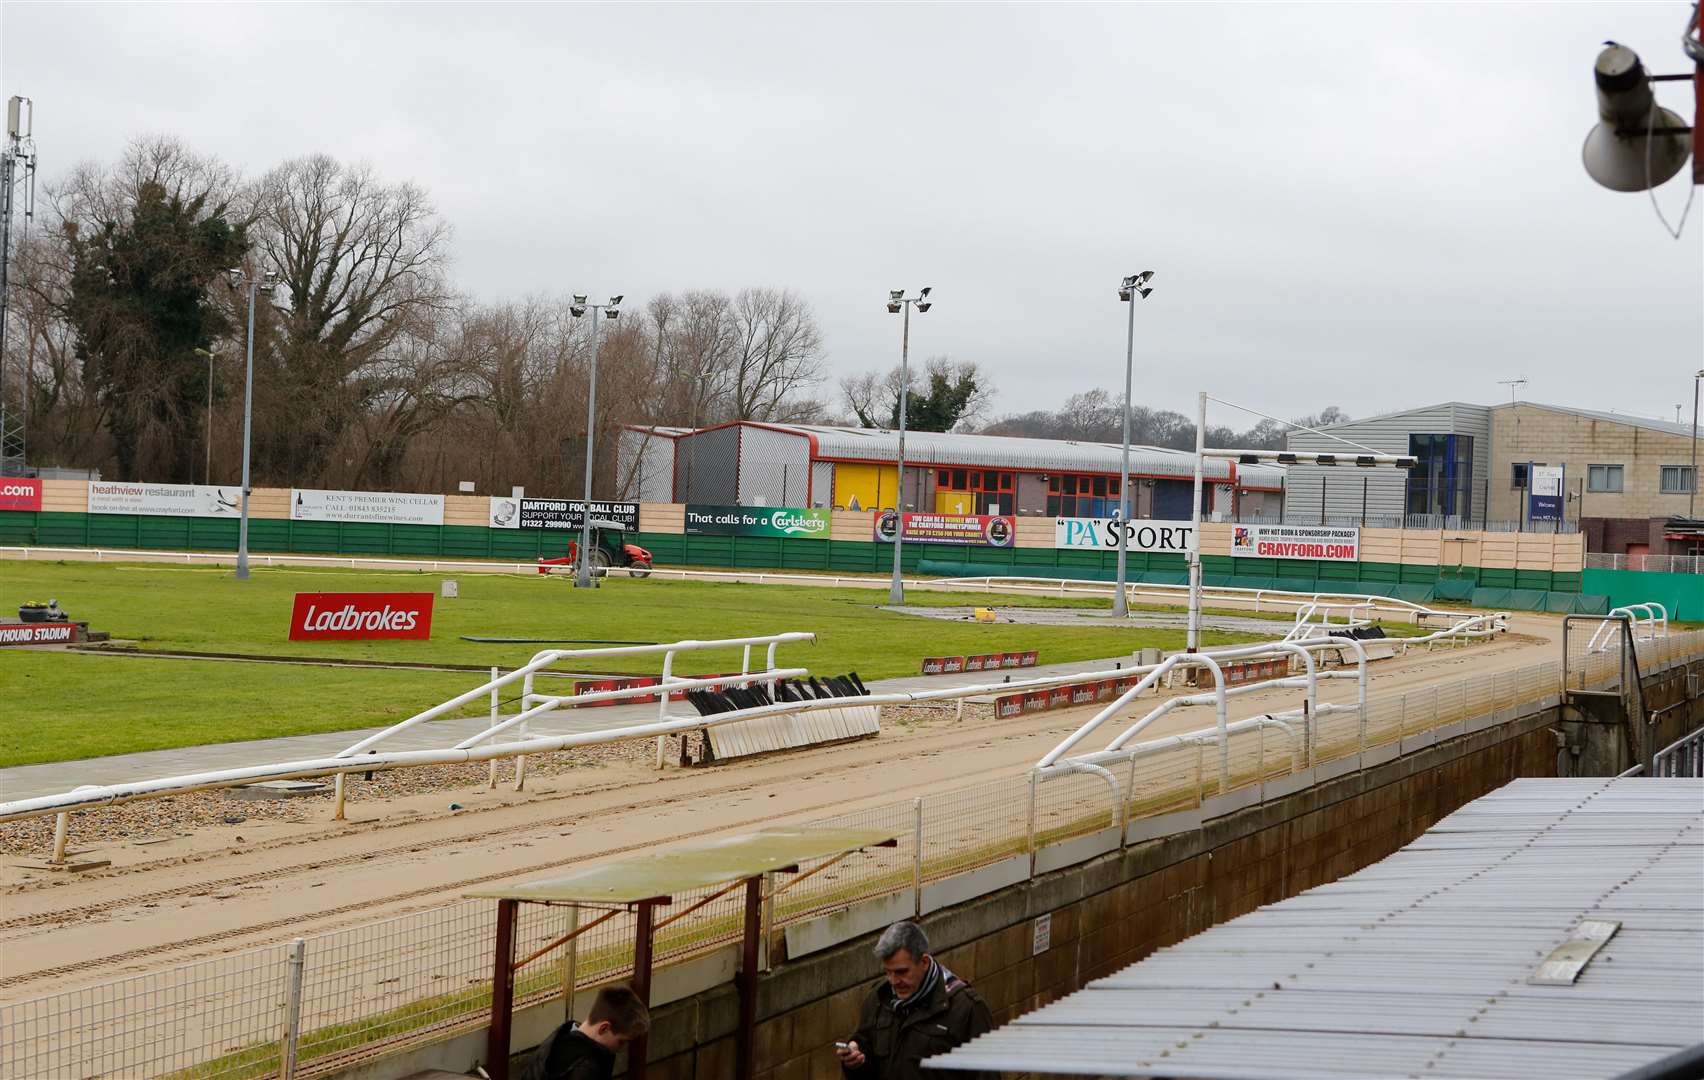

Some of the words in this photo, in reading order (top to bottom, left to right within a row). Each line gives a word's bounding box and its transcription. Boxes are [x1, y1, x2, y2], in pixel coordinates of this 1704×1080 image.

[92, 484, 143, 495] heathview
[145, 487, 195, 498] restaurant
[326, 494, 353, 503] KENT'S
[354, 496, 388, 504] PREMIER
[389, 497, 408, 505] WINE
[522, 500, 567, 511] DARTFORD
[569, 502, 611, 513] FOOBALL
[613, 504, 635, 514] CLUB
[560, 513, 582, 521] YOUR
[612, 514, 635, 522] CLUB!
[688, 513, 713, 524] That
[716, 513, 740, 525] calls
[742, 515, 758, 525] for
[771, 511, 825, 533] Carlsberg
[1105, 521, 1192, 549] SPORT
[1259, 528, 1271, 536] WHY
[1281, 529, 1295, 537] BOOK
[1257, 542, 1355, 559] CRAYFORD.COM
[303, 604, 419, 631] Ladbrokes
[34, 627, 71, 641] STADIUM
[1072, 690, 1094, 703] Ladbrokes
[1001, 702, 1021, 715] Ladbrokes
